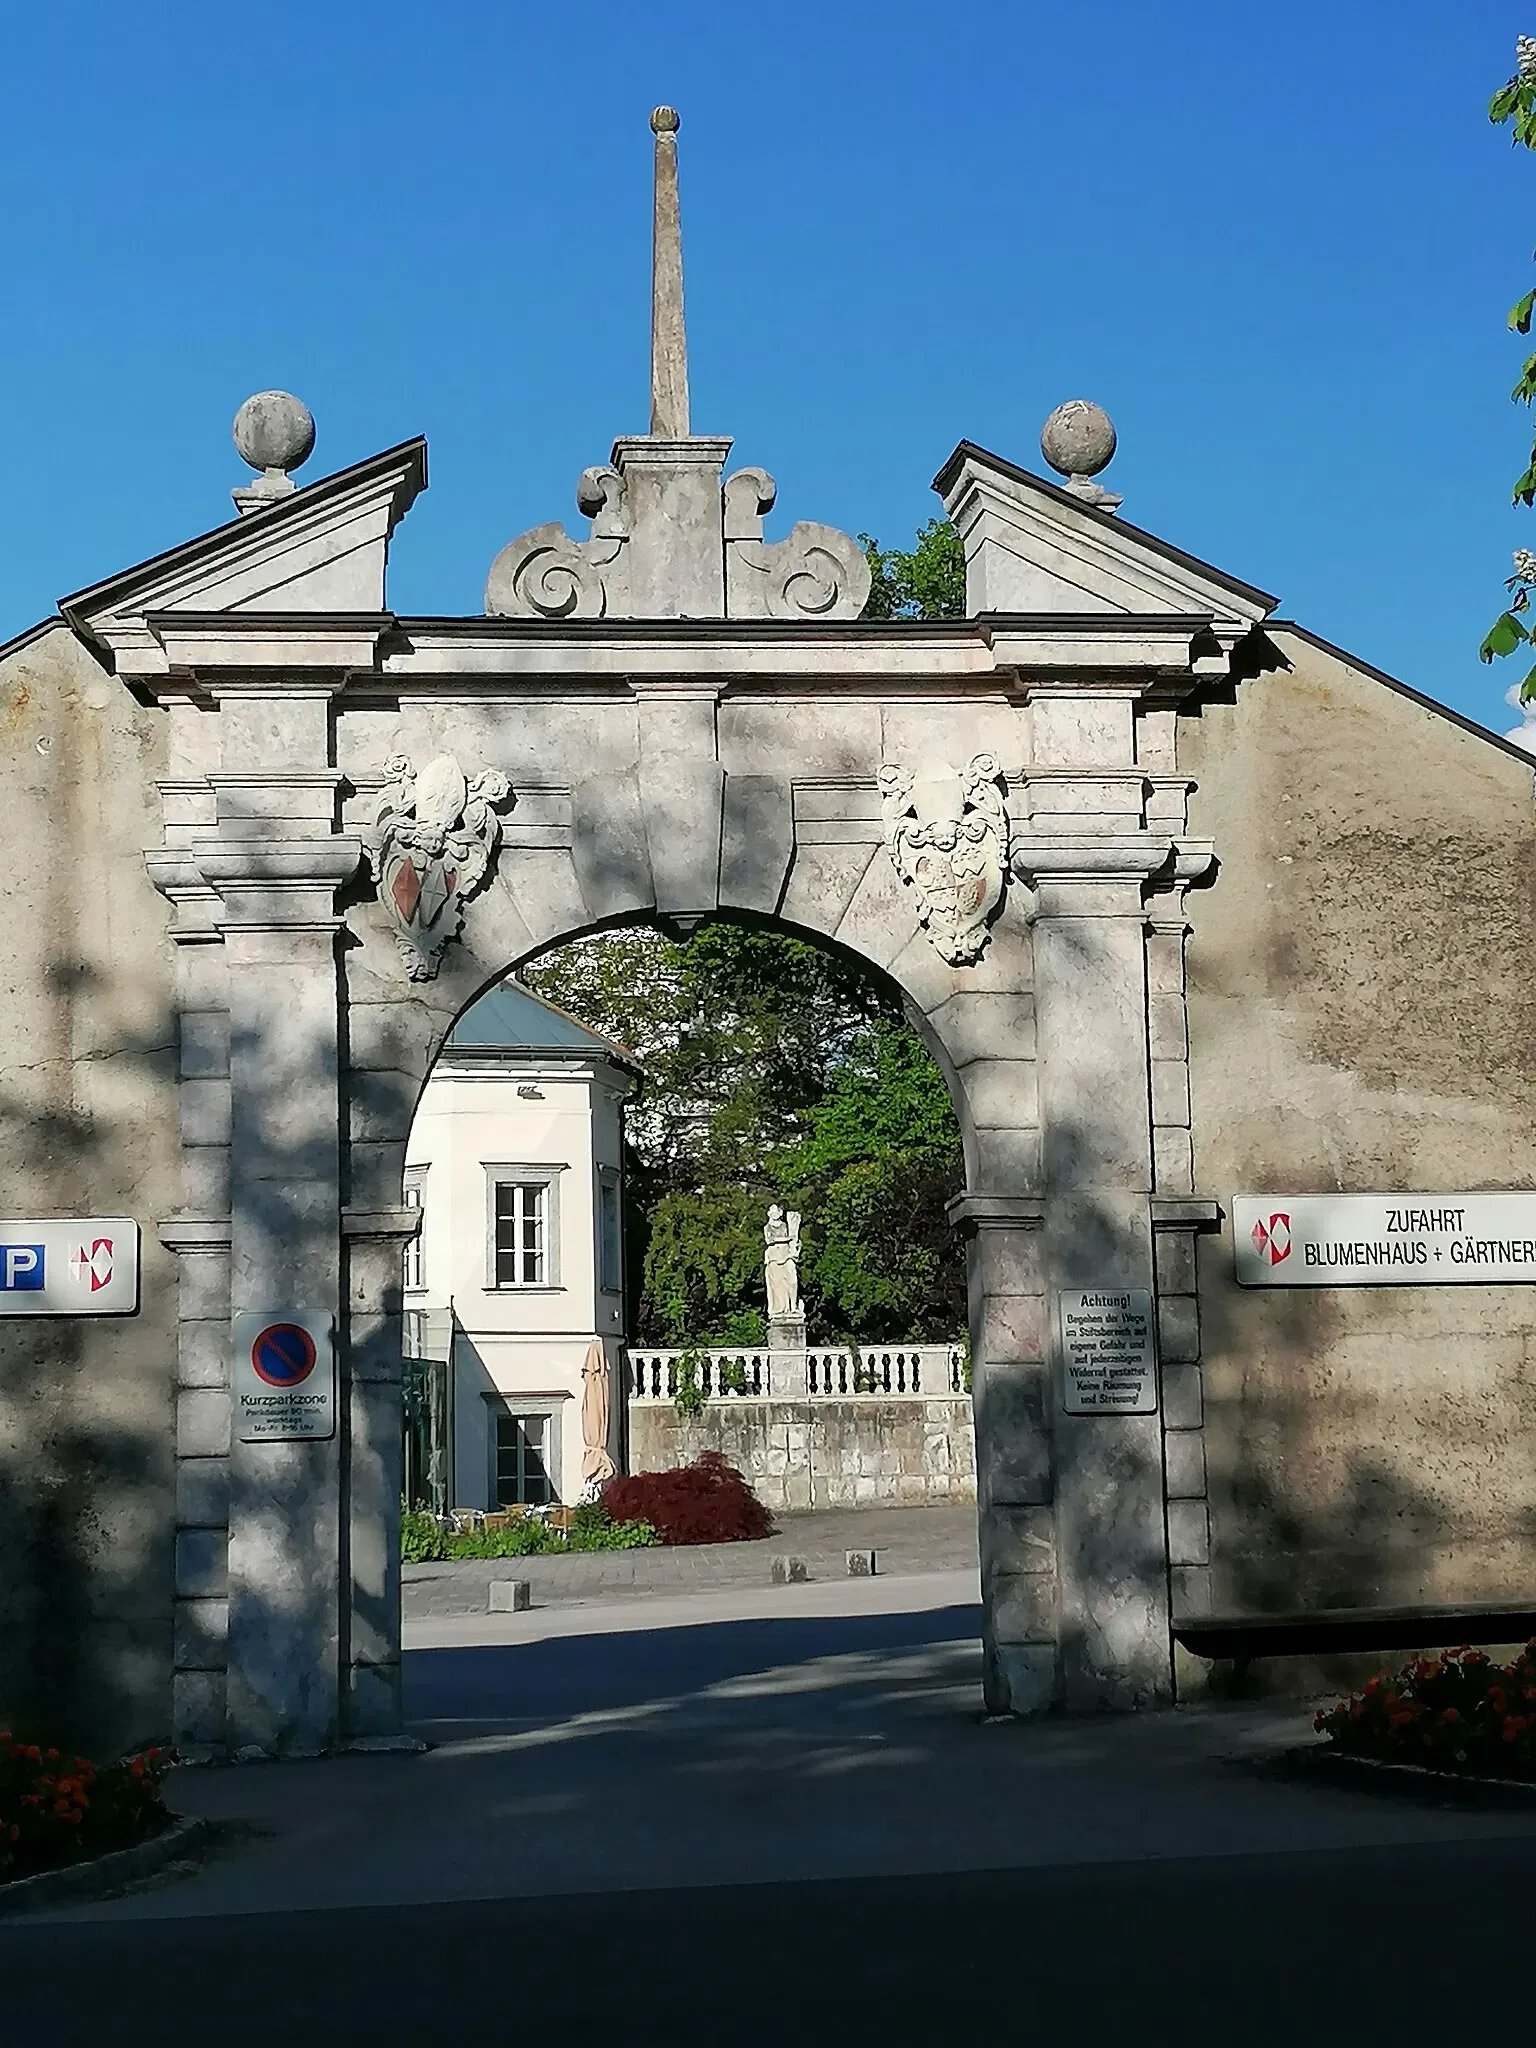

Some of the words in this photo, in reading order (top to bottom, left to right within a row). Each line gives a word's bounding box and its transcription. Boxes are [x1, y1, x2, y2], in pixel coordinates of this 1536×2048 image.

[1386, 1209, 1465, 1232] ZUFAHRT
[1305, 1241, 1427, 1266] BLUMENHAUS
[1433, 1247, 1442, 1261] +
[1450, 1236, 1536, 1263] GÄRTNER
[6, 1248, 38, 1287] P
[1081, 1294, 1131, 1309] Achtung!
[1067, 1314, 1103, 1325] Begehen
[1122, 1313, 1145, 1324] Wege
[1070, 1341, 1096, 1352] eigene
[1100, 1340, 1126, 1350] Gefahr
[1129, 1340, 1145, 1349] und
[1090, 1353, 1142, 1365] jederzeitigen
[1069, 1367, 1106, 1377] Widerruf
[1077, 1381, 1100, 1391] Keine
[240, 1393, 328, 1406] Kurzparkzone
[1081, 1394, 1096, 1404] und
